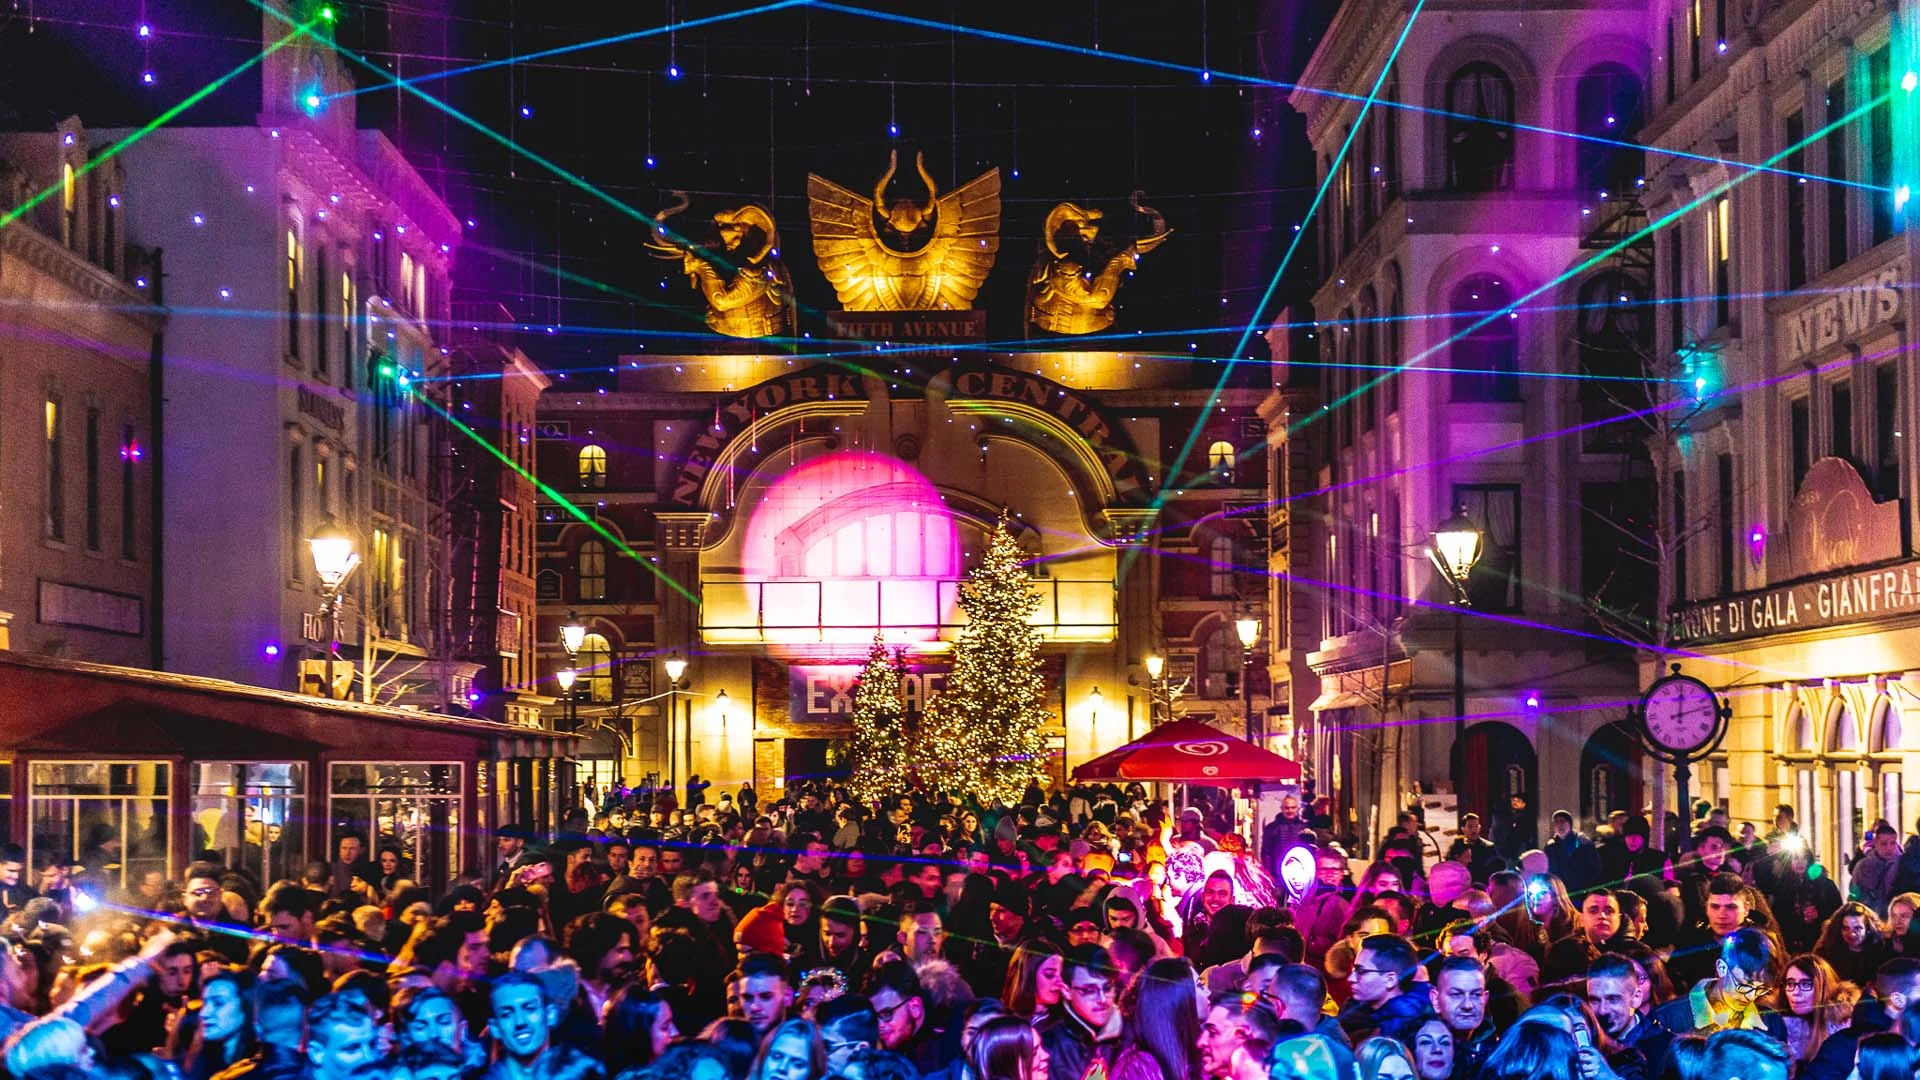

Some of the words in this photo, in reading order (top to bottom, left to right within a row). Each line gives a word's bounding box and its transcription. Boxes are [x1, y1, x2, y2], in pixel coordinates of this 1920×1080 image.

[836, 320, 894, 337] FIFTH
[903, 320, 977, 337] AVENUE
[1783, 267, 1900, 361] NEWS
[671, 424, 728, 506] NEW
[726, 374, 863, 424] YORK
[1663, 604, 1721, 641] ENONE
[1728, 600, 1745, 633] DI
[1751, 590, 1798, 630] GALA
[1817, 566, 1920, 618] GIANFRA
